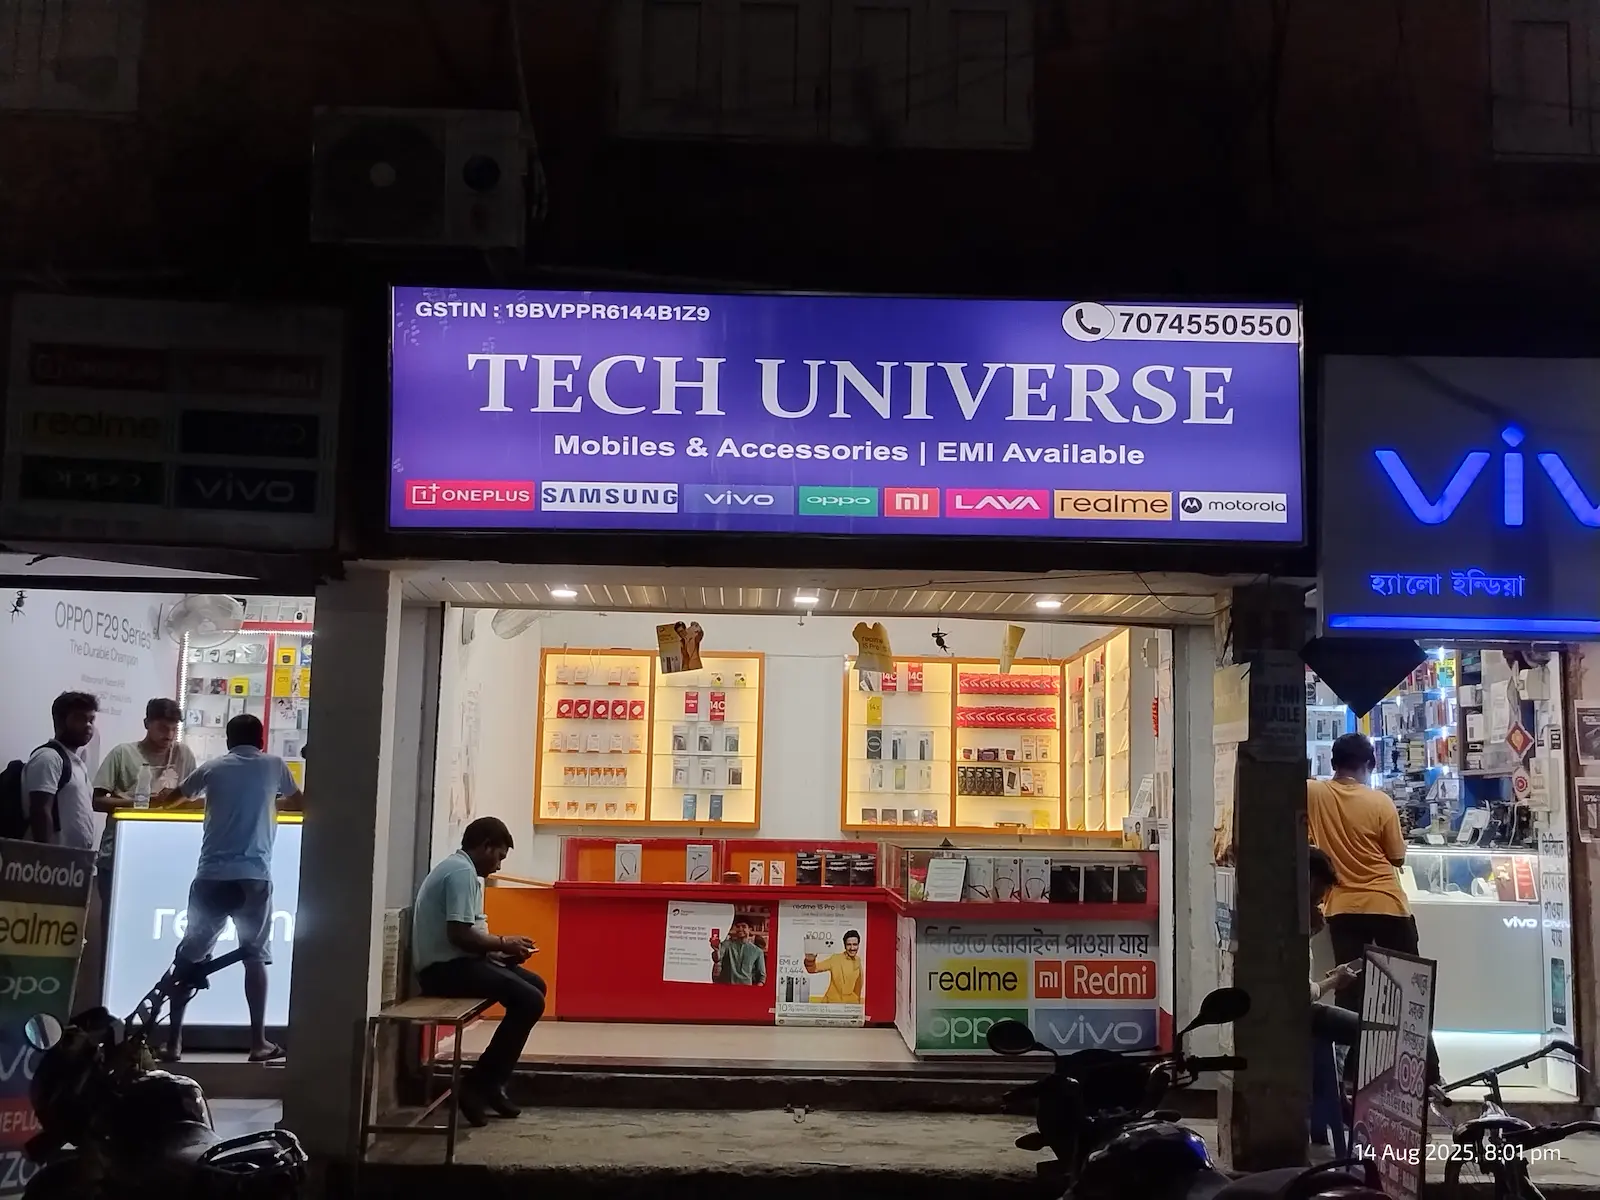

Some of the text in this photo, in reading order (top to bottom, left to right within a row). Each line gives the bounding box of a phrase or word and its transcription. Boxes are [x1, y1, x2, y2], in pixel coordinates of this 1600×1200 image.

[415, 302, 487, 318] GSTIN
[505, 303, 710, 322] 19BVPPR6144B1Z9
[1119, 312, 1292, 336] 7074550550
[467, 353, 1234, 425] TECH UNIVERSE
[33, 409, 160, 438] realme
[554, 434, 675, 457] Mobiles
[686, 437, 709, 458] &
[717, 438, 909, 461] Accessories
[938, 443, 994, 462] EMI
[1002, 443, 1145, 465] Available
[194, 471, 295, 503] vivo
[442, 488, 530, 503] ONEPLUS
[543, 487, 678, 505] SAMSUNG
[704, 490, 774, 506] vivo
[806, 494, 871, 507] oppo
[955, 494, 1040, 510] LAVA
[1060, 495, 1168, 514] realme
[1208, 498, 1286, 512] motorola
[1370, 568, 1526, 599] হ্যালো ইন্ডিয়া
[55, 600, 151, 650] OPPO F29 Series
[70, 639, 139, 668] The Durable Champion
[4, 860, 85, 887] motorola
[1503, 916, 1537, 928] vivo
[991, 927, 1061, 956] মোবাইল
[1064, 933, 1115, 957] পাওয়া
[1118, 933, 1150, 957] যায়
[927, 965, 1018, 992] realme
[1073, 965, 1147, 995] Redmi
[1362, 959, 1402, 1027] HELLO
[928, 1016, 1015, 1043] opp
[1048, 1014, 1143, 1045] vivo
[1357, 1029, 1397, 1090] INDIA
